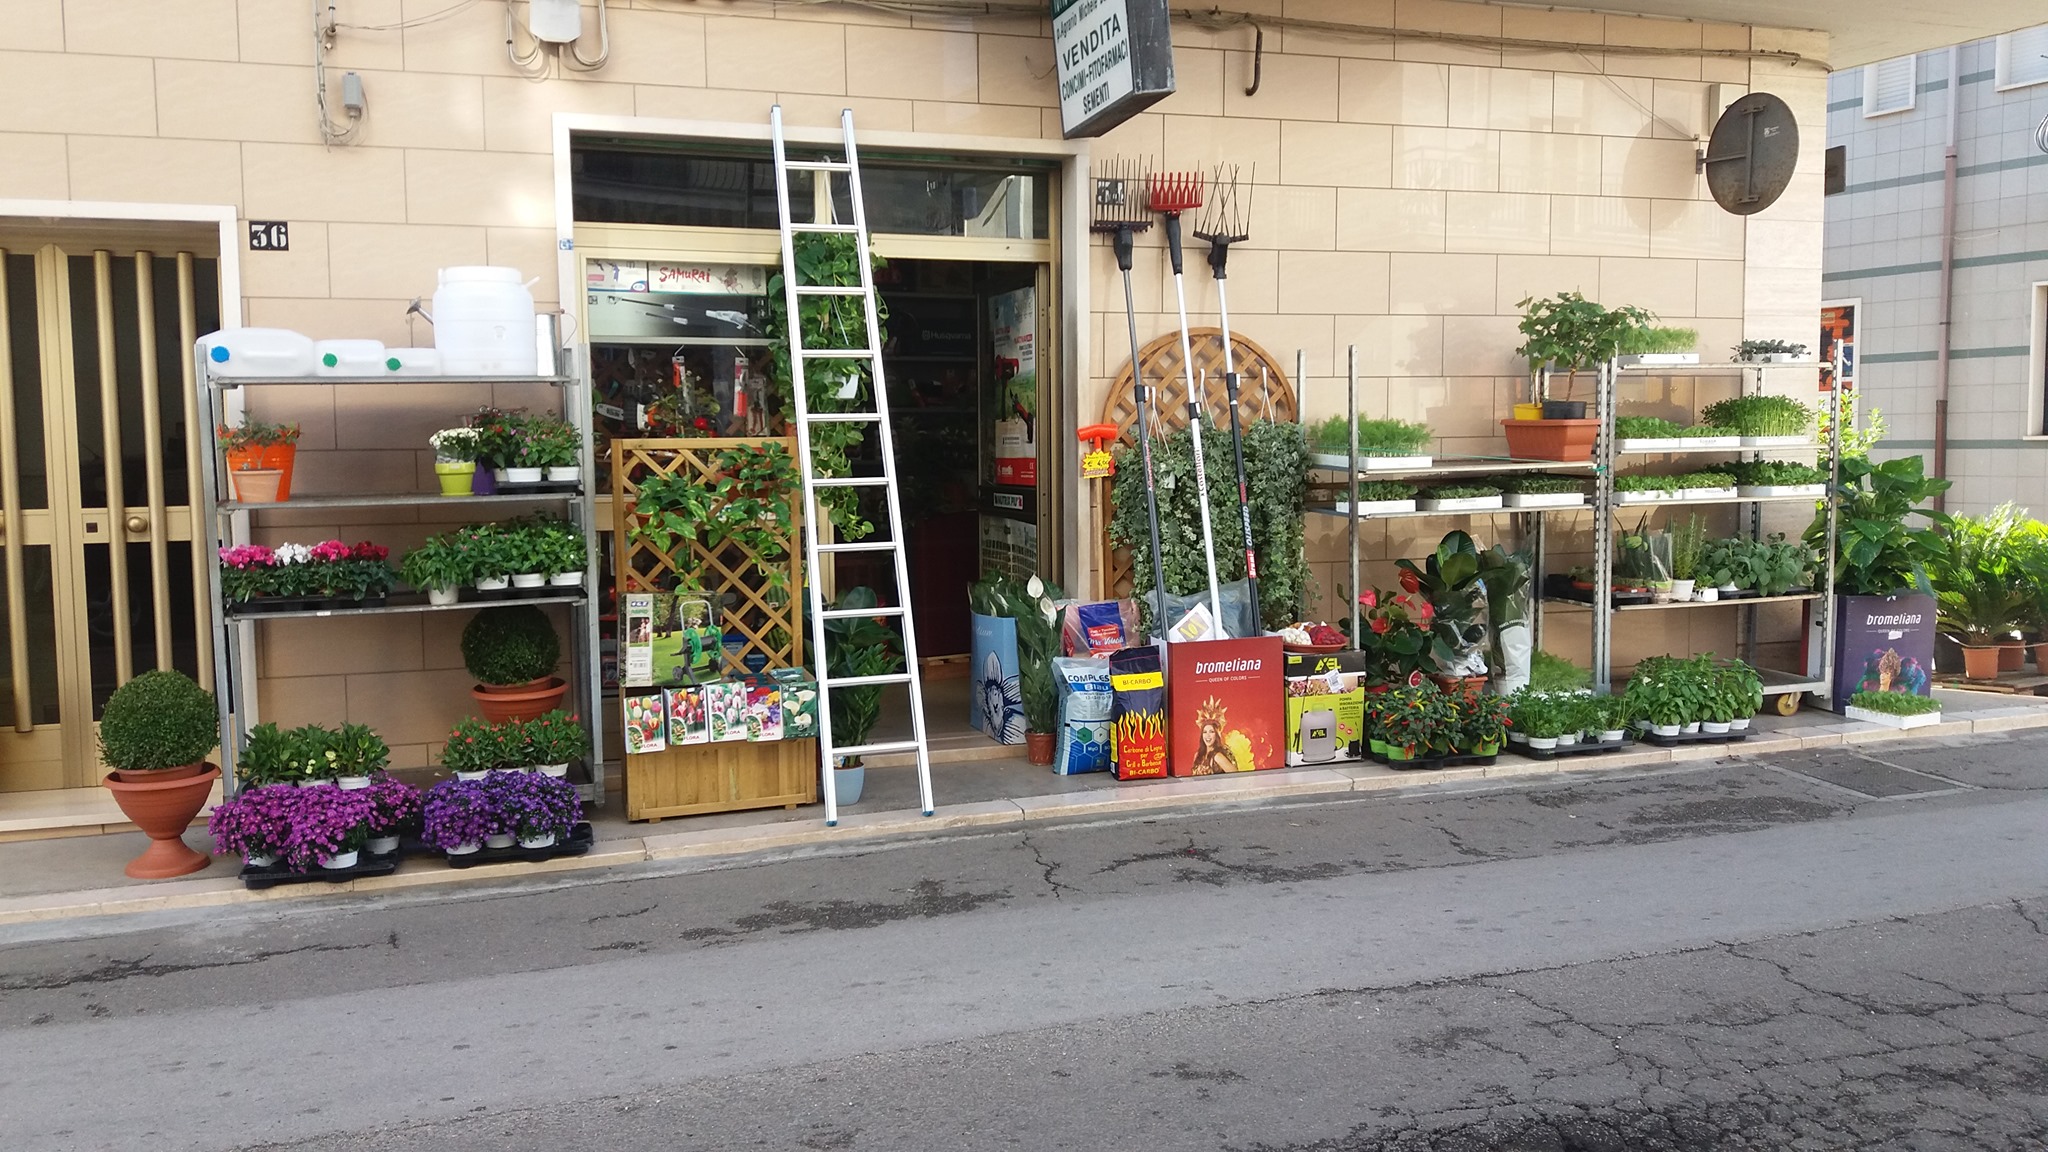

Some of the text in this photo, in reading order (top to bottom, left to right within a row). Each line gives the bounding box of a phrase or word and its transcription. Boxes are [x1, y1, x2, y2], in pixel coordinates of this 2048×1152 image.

[1063, 13, 1121, 71] VENDITA
[1062, 38, 1129, 101] CONCIMI-FITOFARMACI
[1083, 81, 1110, 115] SEMENTI
[251, 224, 287, 247] 36
[1866, 612, 1922, 626] bromeliana
[1195, 657, 1261, 674] bromeliana
[1084, 683, 1109, 691] Blau
[1129, 767, 1160, 776] BI-CARBO
